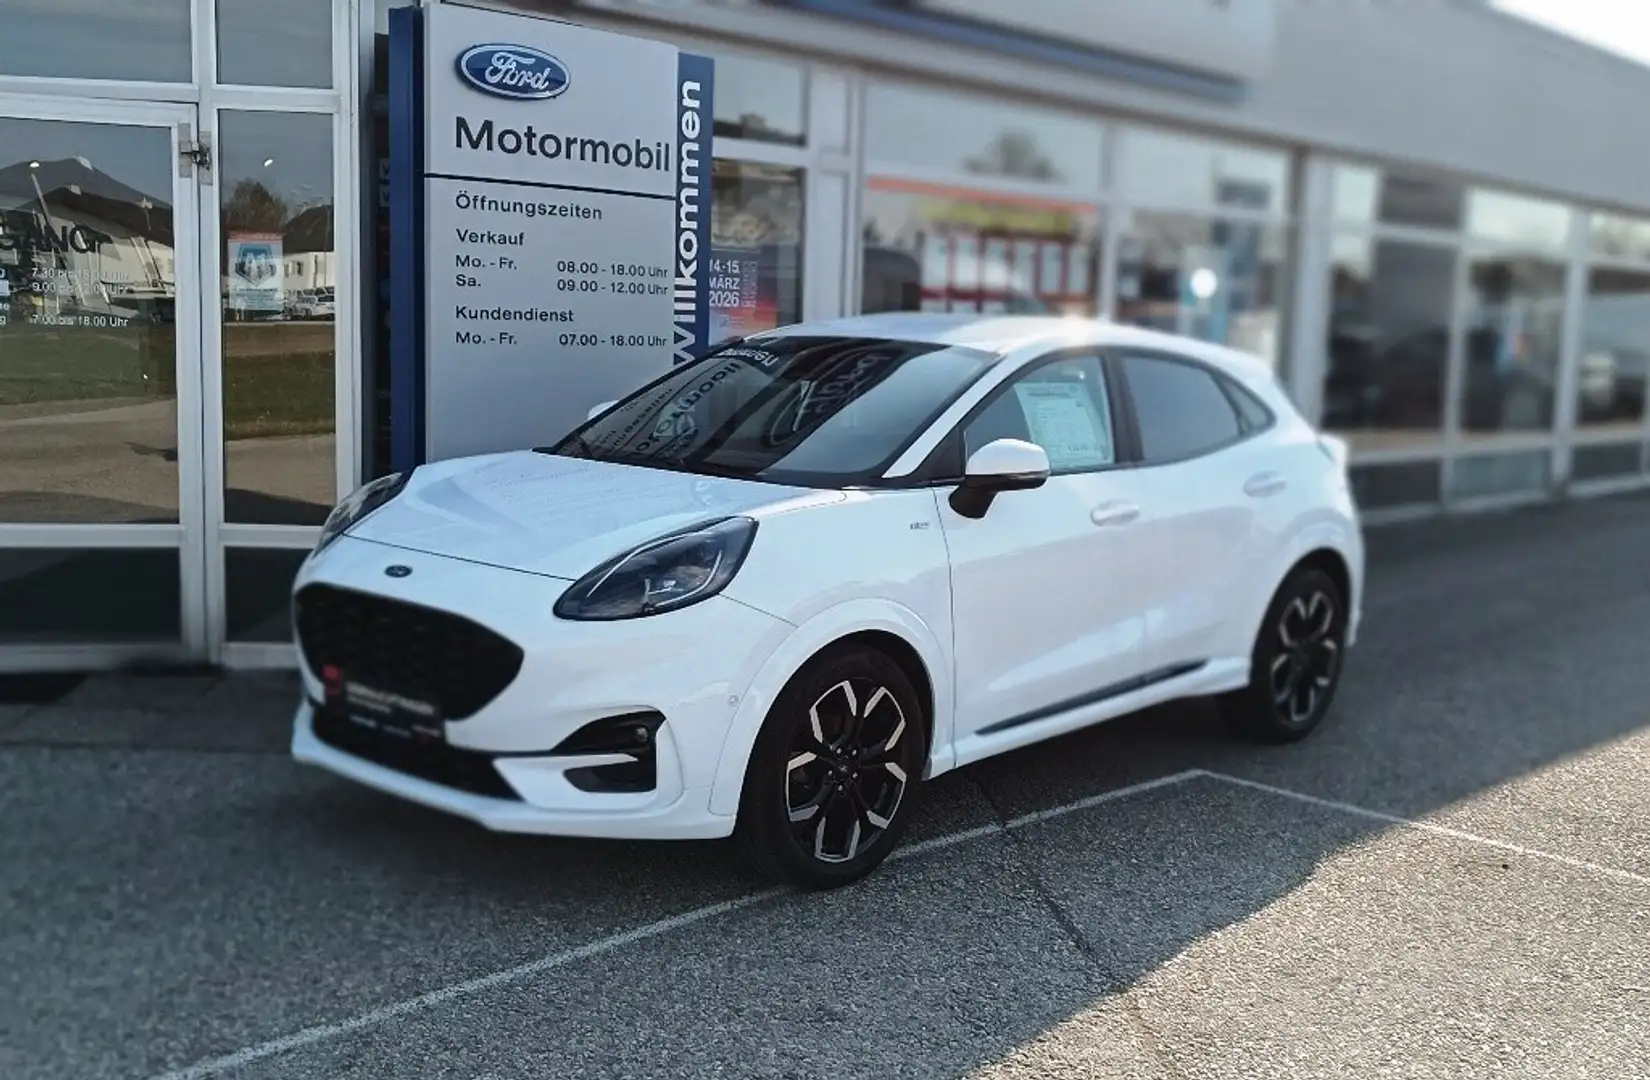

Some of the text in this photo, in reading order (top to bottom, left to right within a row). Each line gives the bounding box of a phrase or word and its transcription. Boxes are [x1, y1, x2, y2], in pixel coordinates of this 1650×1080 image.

[485, 51, 551, 90] Ford
[456, 116, 670, 172] Motormobil
[455, 190, 602, 220] Öffnungszeiten
[456, 228, 525, 246] Verkauf
[32, 268, 55, 278] 7.30
[455, 255, 486, 268] Mo.
[499, 257, 517, 270] Fr.
[557, 261, 598, 274] 08.00
[610, 264, 646, 277] 18.00
[647, 266, 668, 278] Uhr
[32, 282, 56, 292] 9.00
[455, 274, 481, 287] Sa.
[557, 279, 598, 292] 09.00
[610, 282, 646, 295] 12.00
[647, 284, 668, 295] Uhr
[709, 291, 740, 307] 2026
[79, 316, 107, 327] 18.00
[109, 317, 129, 327] Uhr
[455, 305, 574, 322] Kundendienst
[455, 332, 486, 345] Mo.
[499, 333, 517, 345] Fr.
[559, 333, 598, 347] 07.00
[610, 335, 645, 347] 18.00
[647, 335, 667, 347] Uhr
